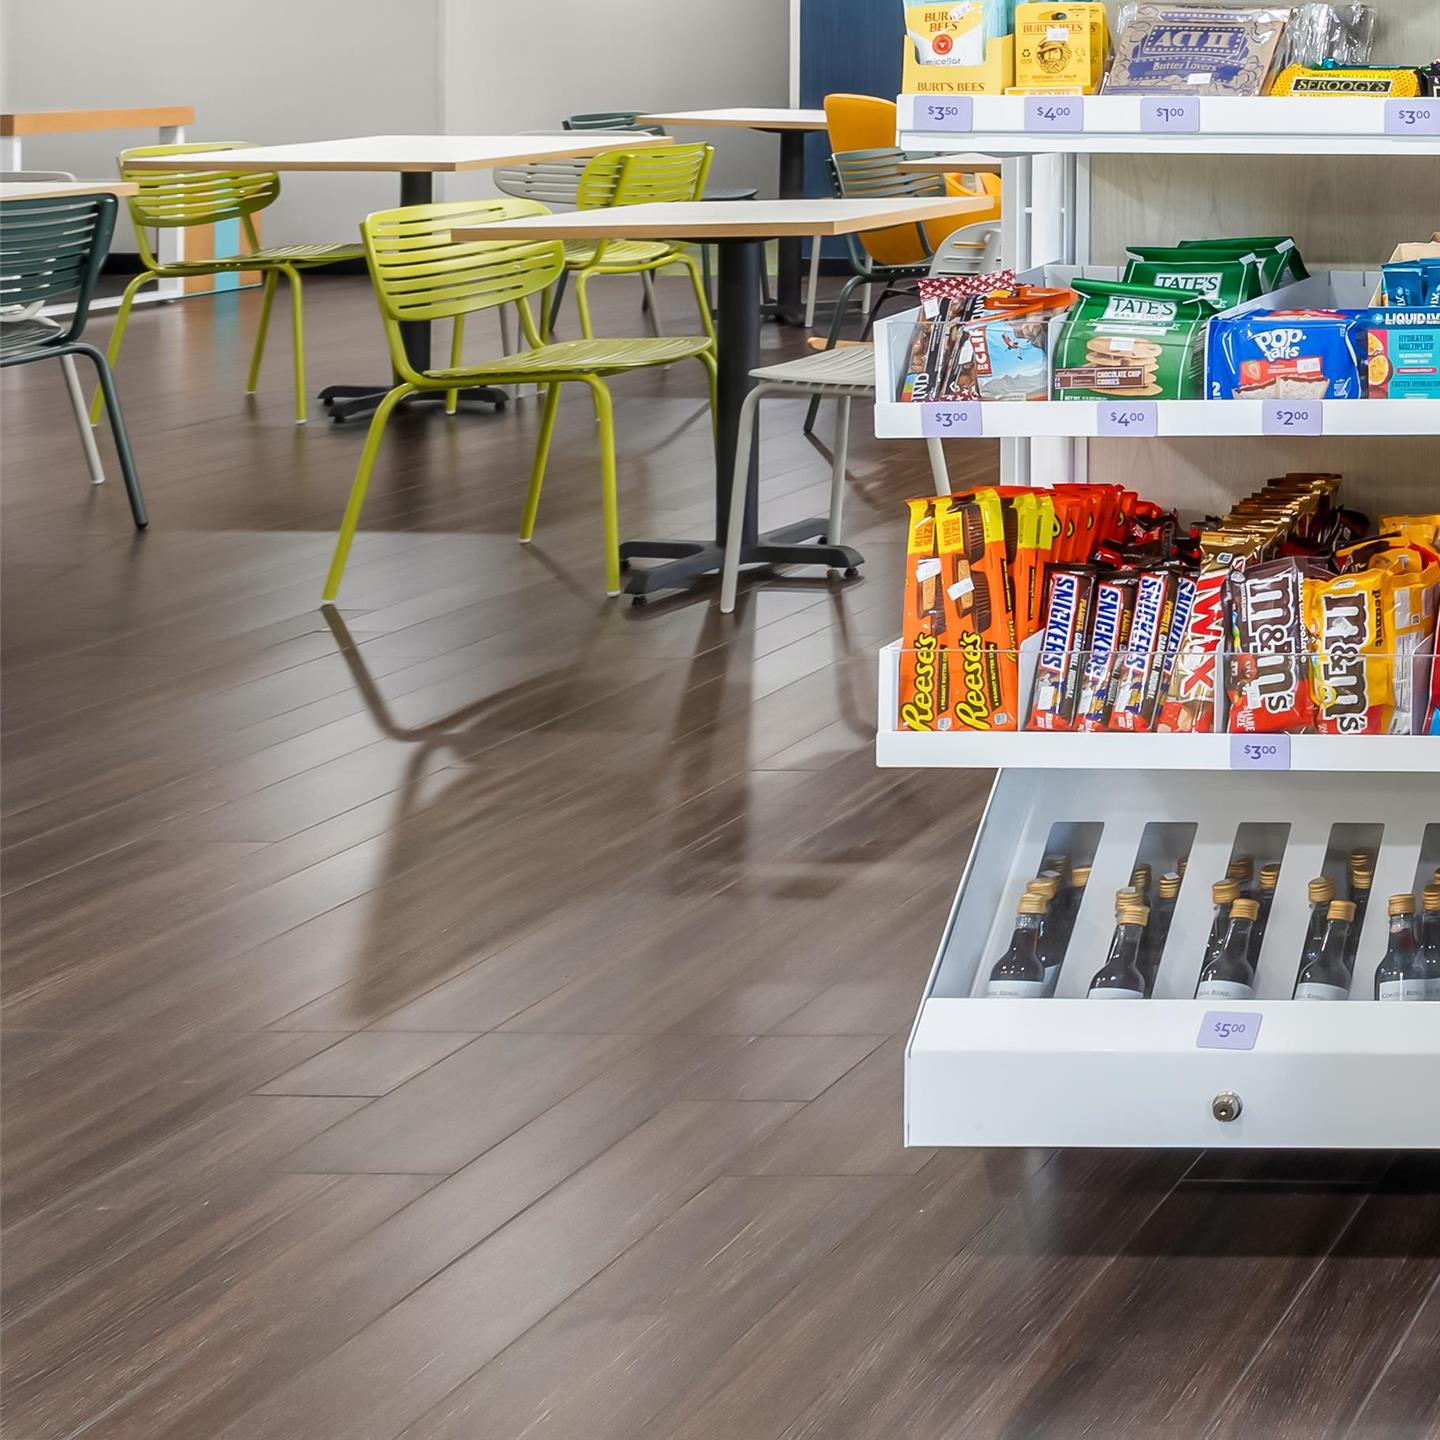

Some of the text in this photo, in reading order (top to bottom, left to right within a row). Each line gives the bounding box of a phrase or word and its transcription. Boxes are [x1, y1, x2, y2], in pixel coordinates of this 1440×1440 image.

[1155, 31, 1234, 47] ACT II
[1152, 61, 1217, 71] Butter Lovers
[917, 81, 985, 92] BURT'S BEES
[1298, 80, 1388, 92] SEROOGY'S
[1112, 297, 1174, 315] TATE'S
[1042, 575, 1074, 670] SNICKERS
[955, 630, 983, 731] Reese's
